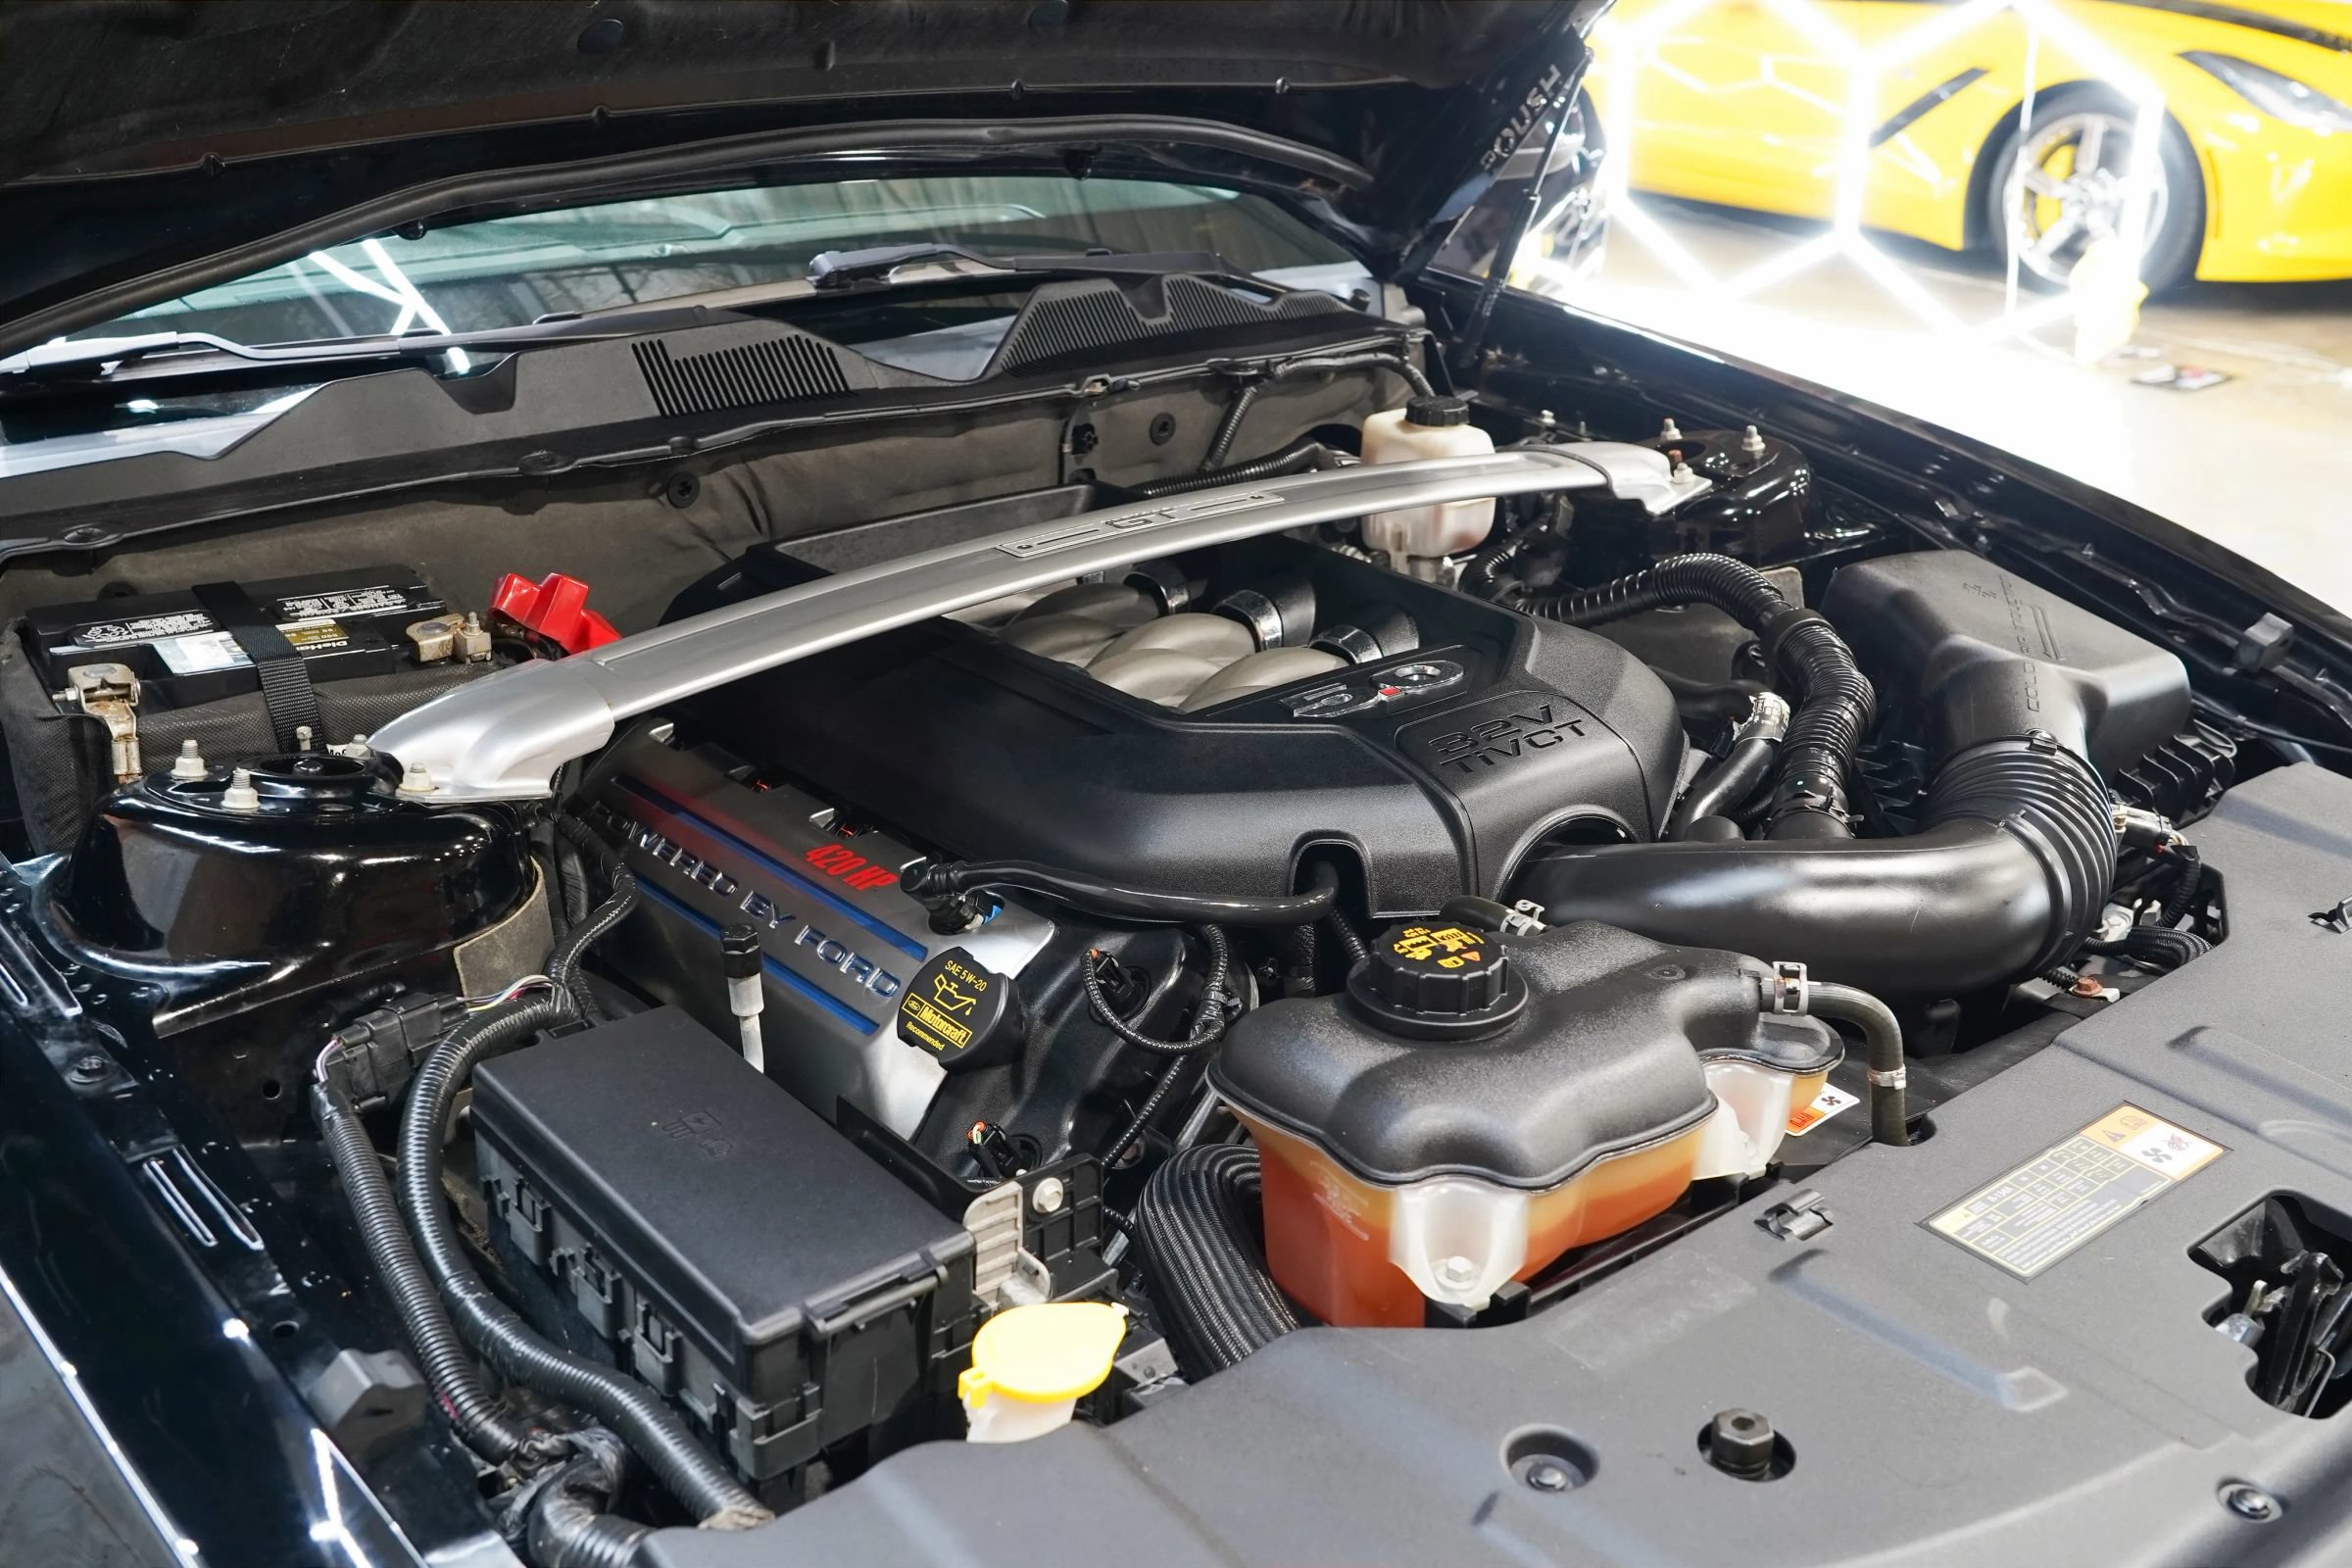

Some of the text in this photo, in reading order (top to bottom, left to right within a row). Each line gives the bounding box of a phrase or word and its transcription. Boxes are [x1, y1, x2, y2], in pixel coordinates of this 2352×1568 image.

[1278, 660, 1465, 718] 5.0
[1428, 704, 1553, 756] 32V
[806, 844, 899, 891] 420 HP
[589, 800, 902, 998] POWERED BY FORD
[944, 959, 988, 992] SAE 5W-20
[906, 1020, 946, 1052] Recommended
[919, 1005, 967, 1046] Motorcraft
